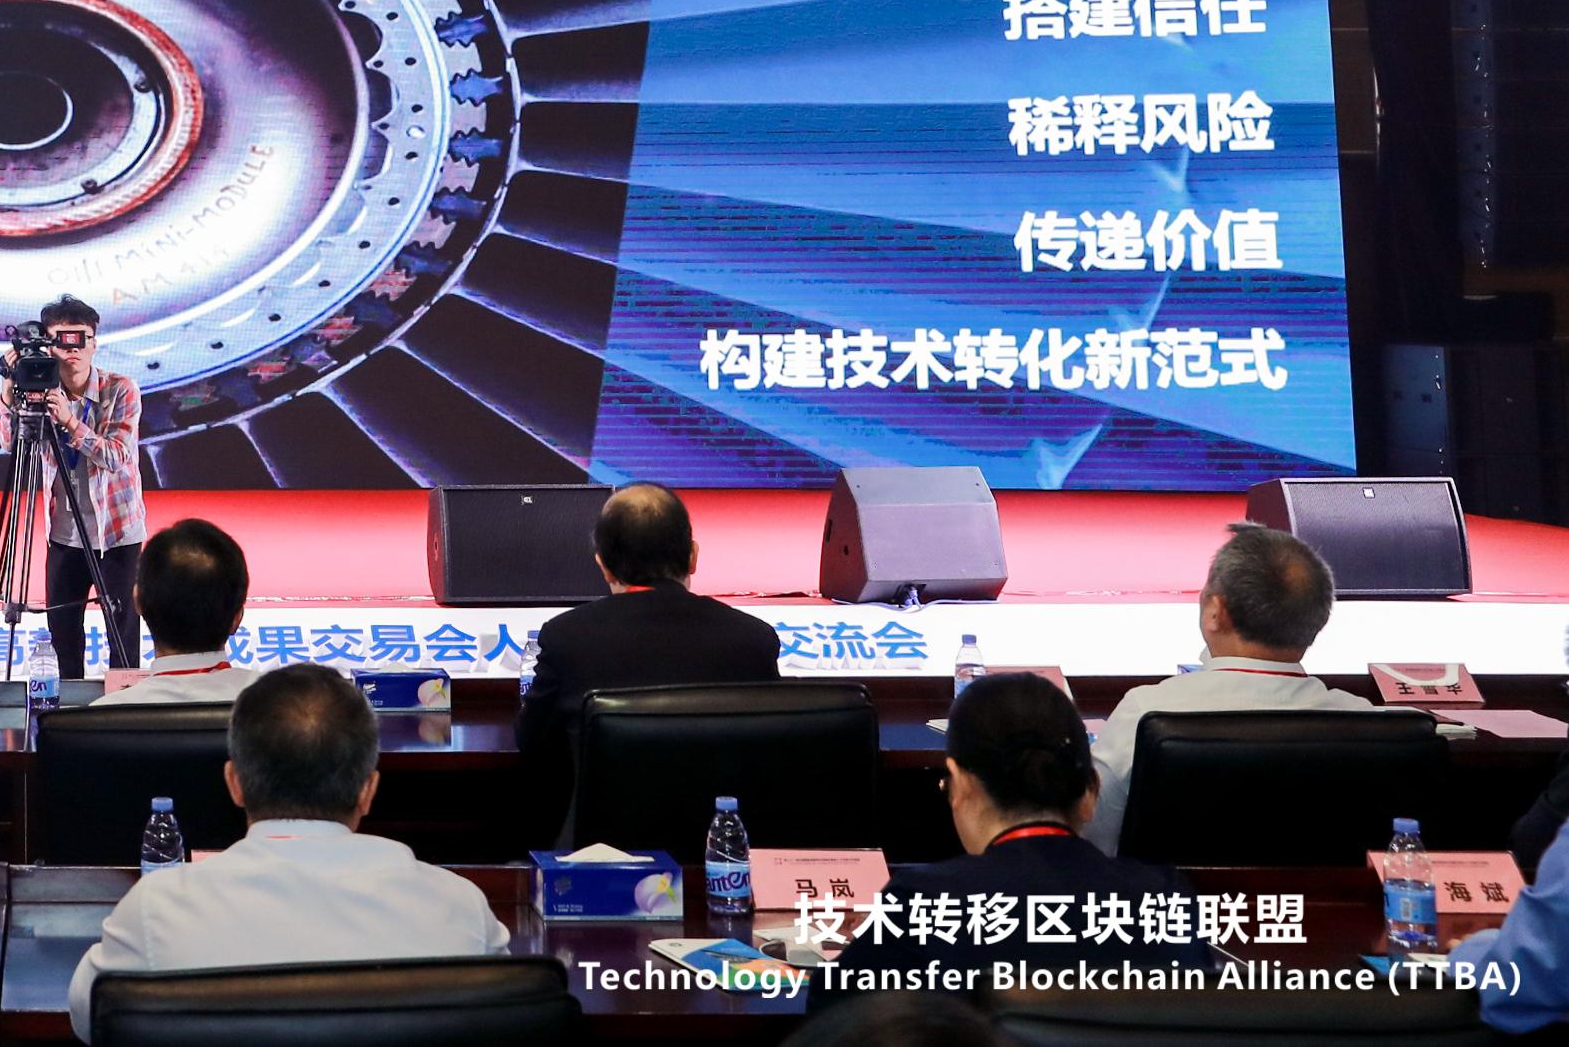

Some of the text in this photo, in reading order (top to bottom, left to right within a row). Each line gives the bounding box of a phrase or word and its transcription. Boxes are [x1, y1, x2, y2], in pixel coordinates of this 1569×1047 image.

[1007, 91, 1275, 156] 稀释风险
[1013, 209, 1283, 273] 传递价值
[699, 327, 1288, 391] 构建技术转化新范式
[1443, 881, 1510, 903] 海斌
